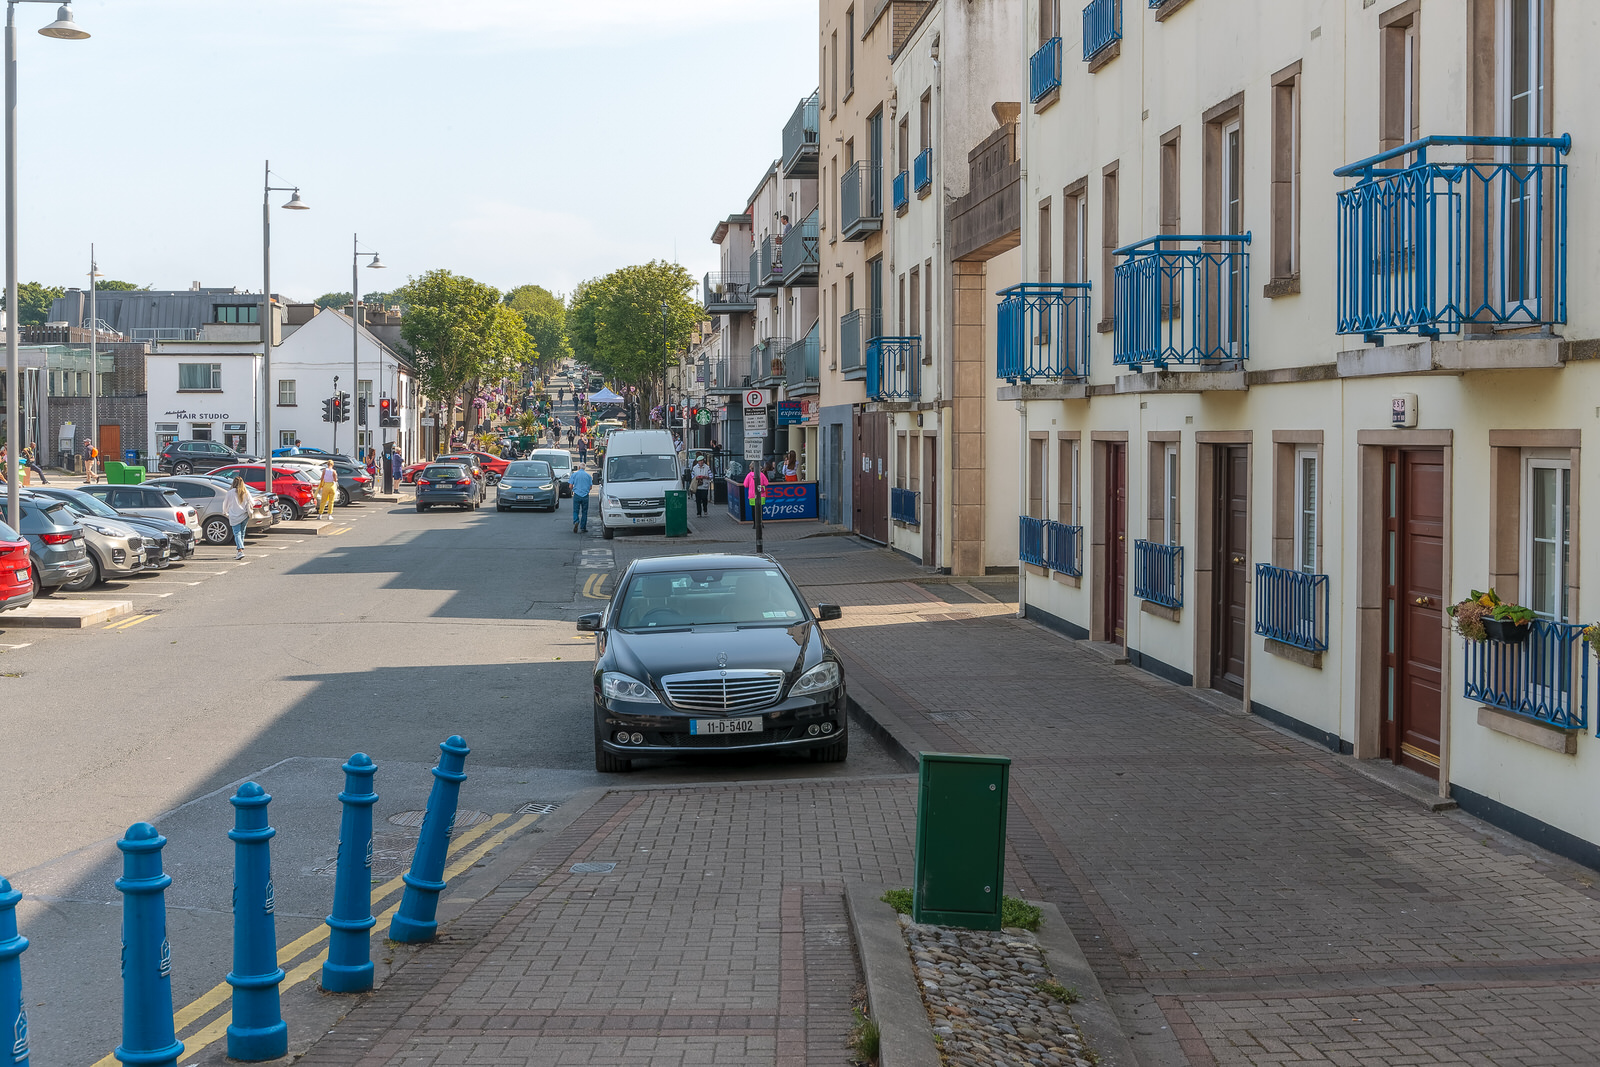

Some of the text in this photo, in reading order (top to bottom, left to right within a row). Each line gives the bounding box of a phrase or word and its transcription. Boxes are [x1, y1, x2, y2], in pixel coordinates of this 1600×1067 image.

[751, 393, 758, 404] P
[766, 486, 806, 497] ESCO
[762, 504, 804, 517] xpress
[707, 720, 753, 732] 11-D-5402
